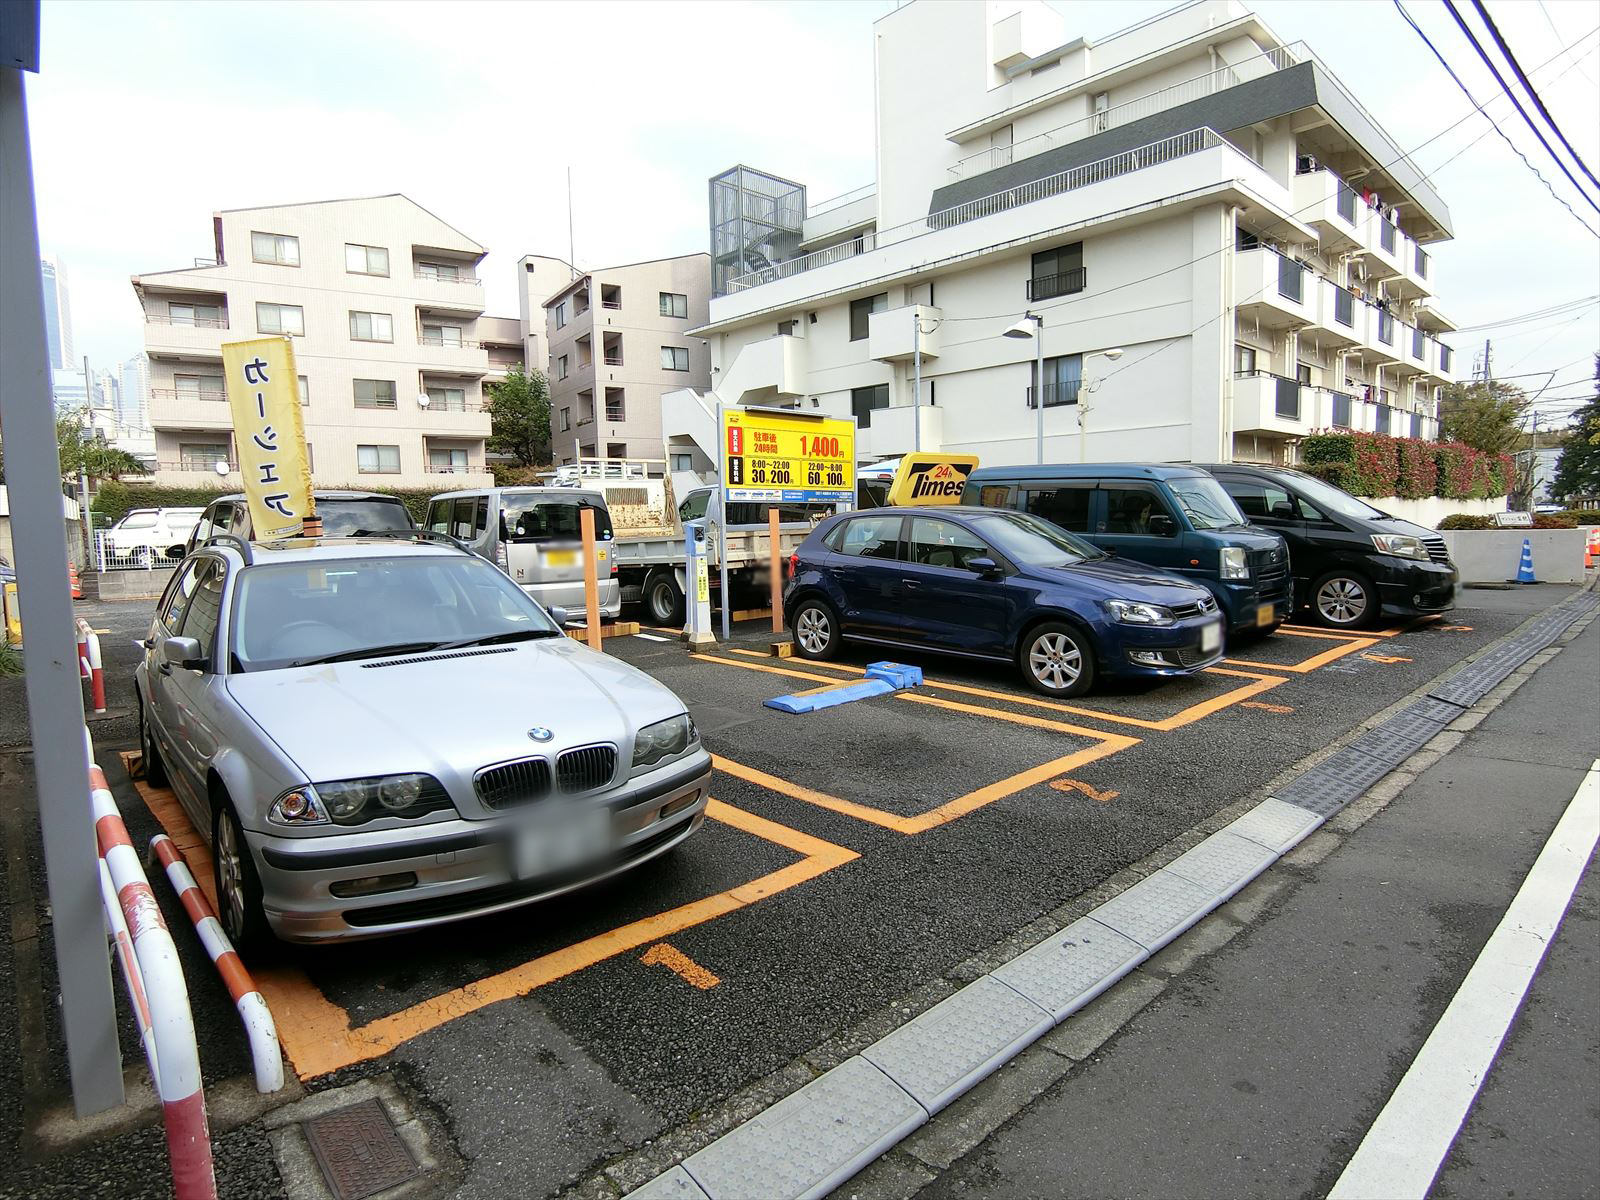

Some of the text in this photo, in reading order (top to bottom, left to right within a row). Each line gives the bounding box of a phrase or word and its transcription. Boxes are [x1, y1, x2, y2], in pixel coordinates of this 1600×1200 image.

[754, 443, 778, 454] 24時間
[800, 435, 844, 458] 1,400円
[911, 473, 966, 499] Times
[1049, 779, 1121, 802] 2
[640, 942, 721, 990] 1
